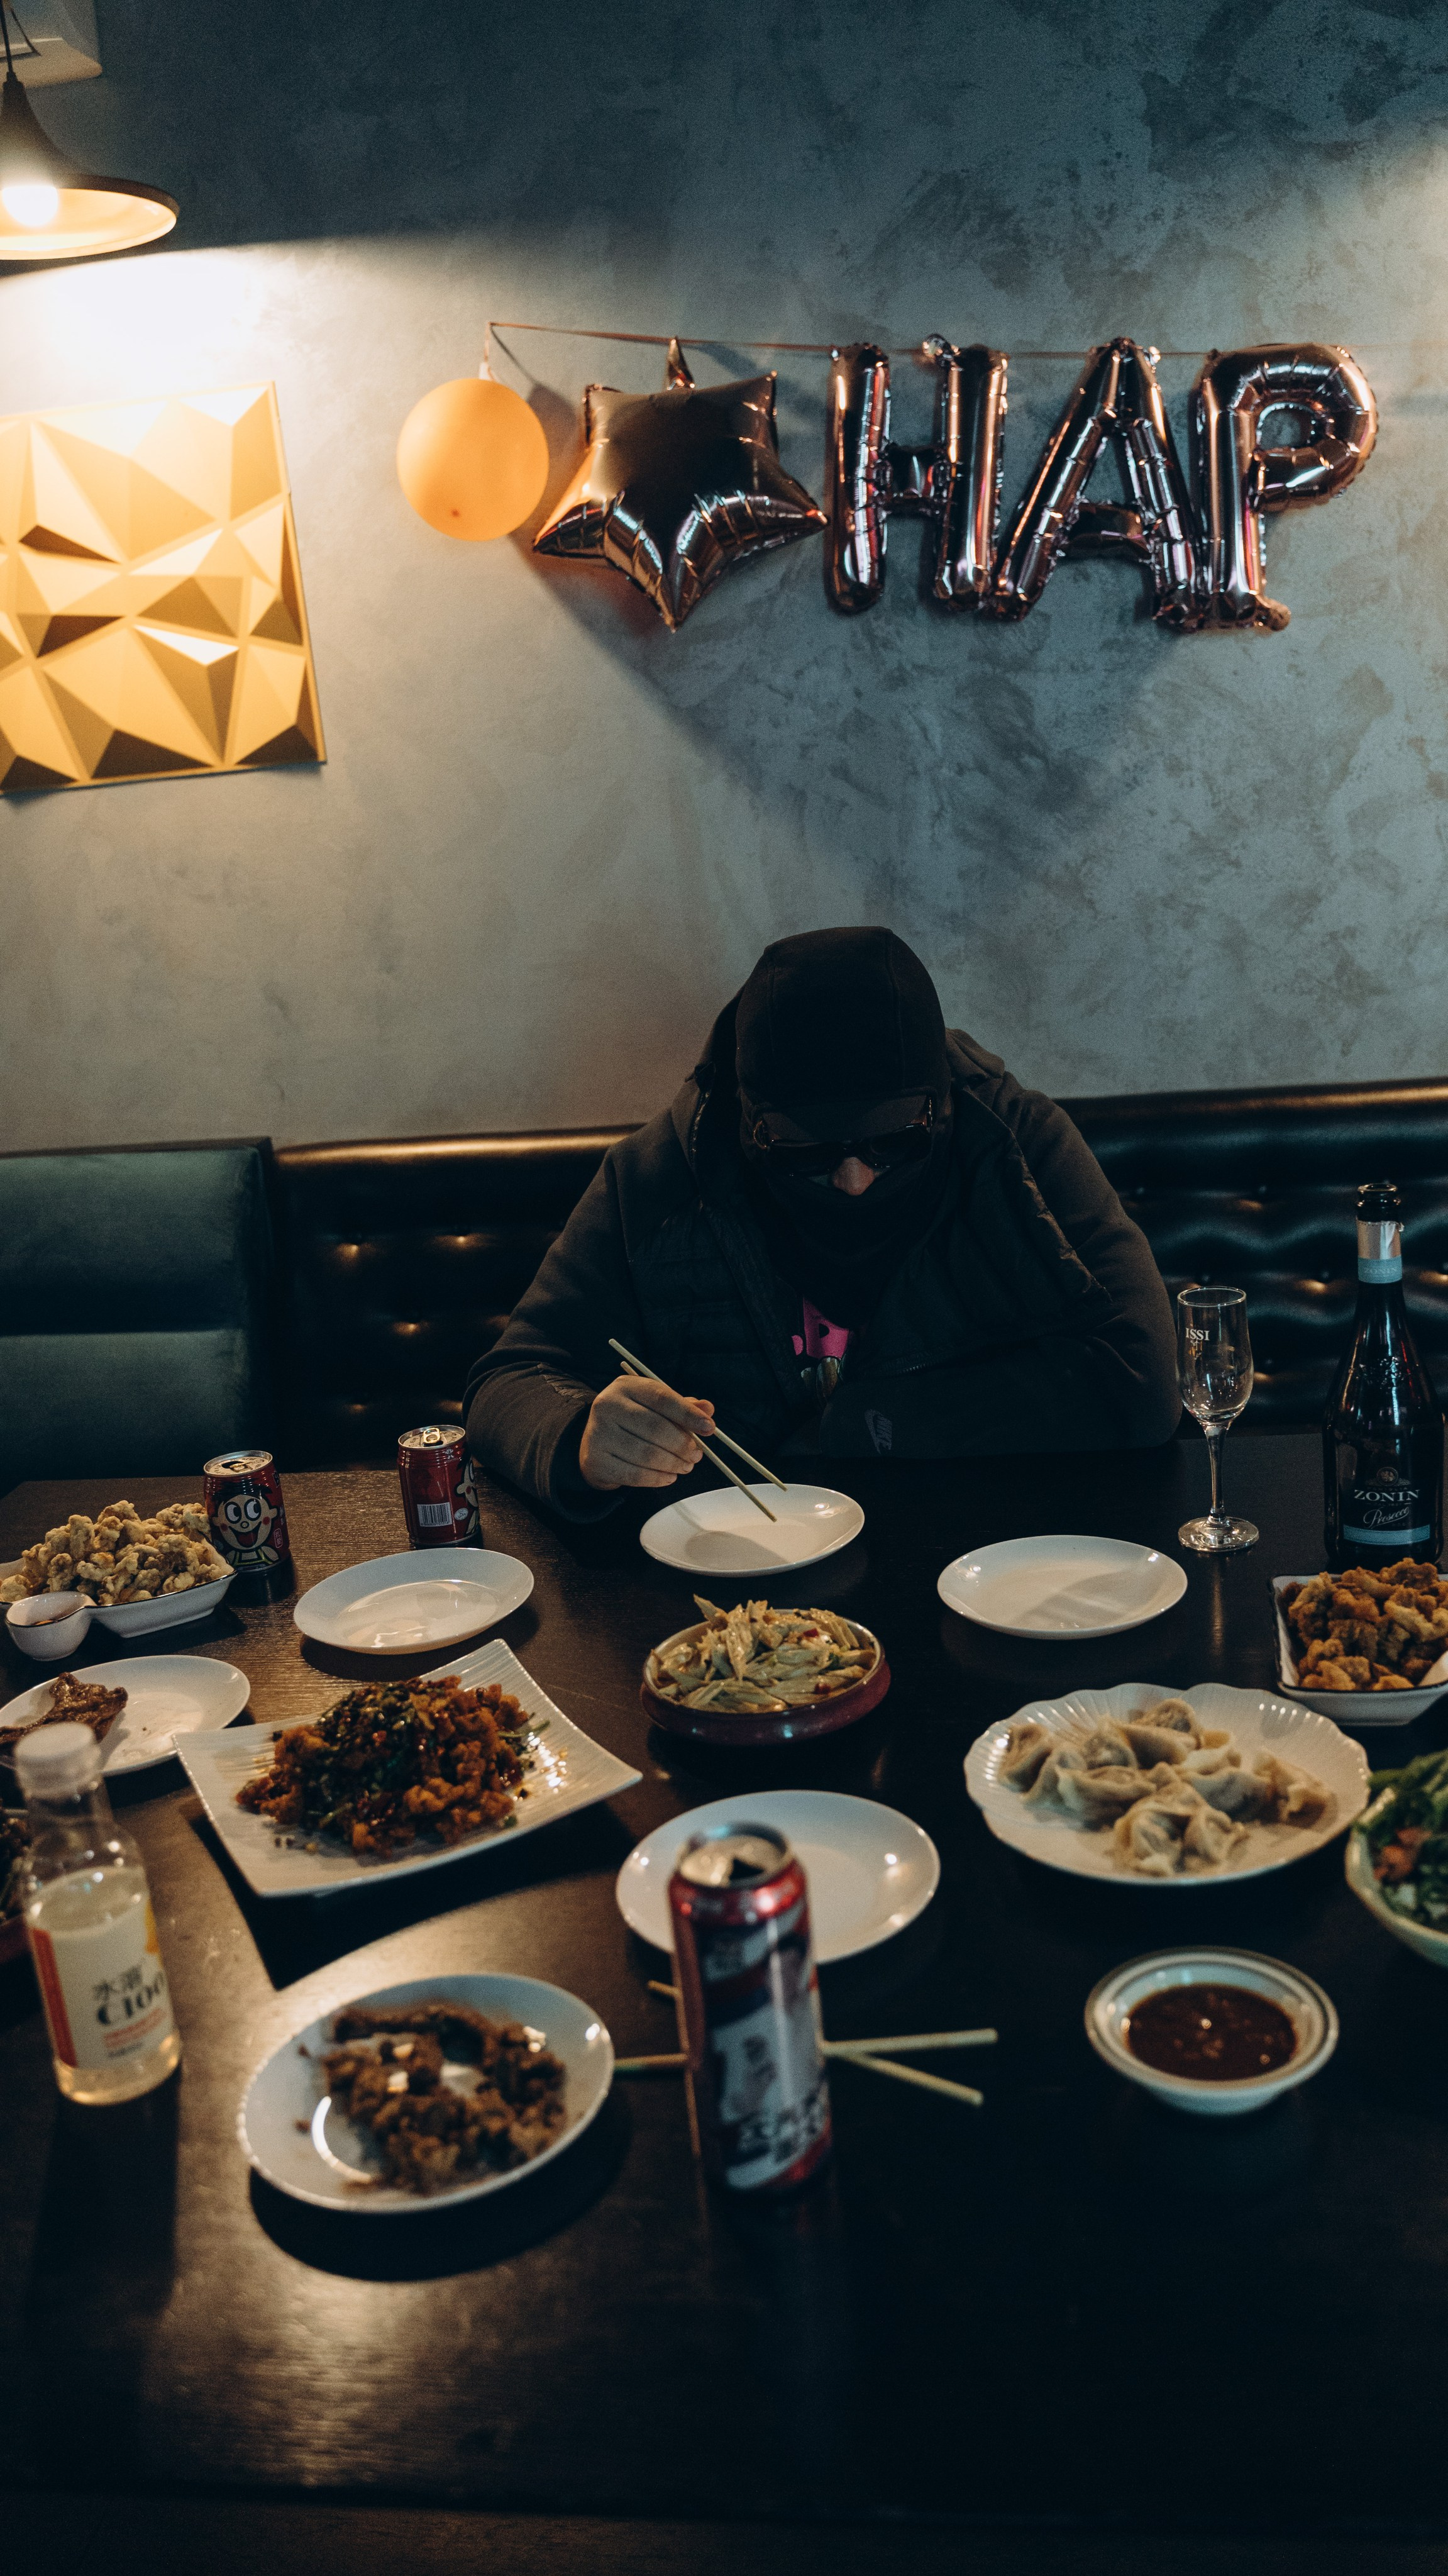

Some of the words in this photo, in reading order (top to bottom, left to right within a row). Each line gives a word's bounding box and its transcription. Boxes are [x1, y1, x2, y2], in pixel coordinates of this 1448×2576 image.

[827, 336, 1378, 631] HAP
[876, 1414, 892, 1450] NIKE
[1354, 1489, 1420, 1501] ZONIN
